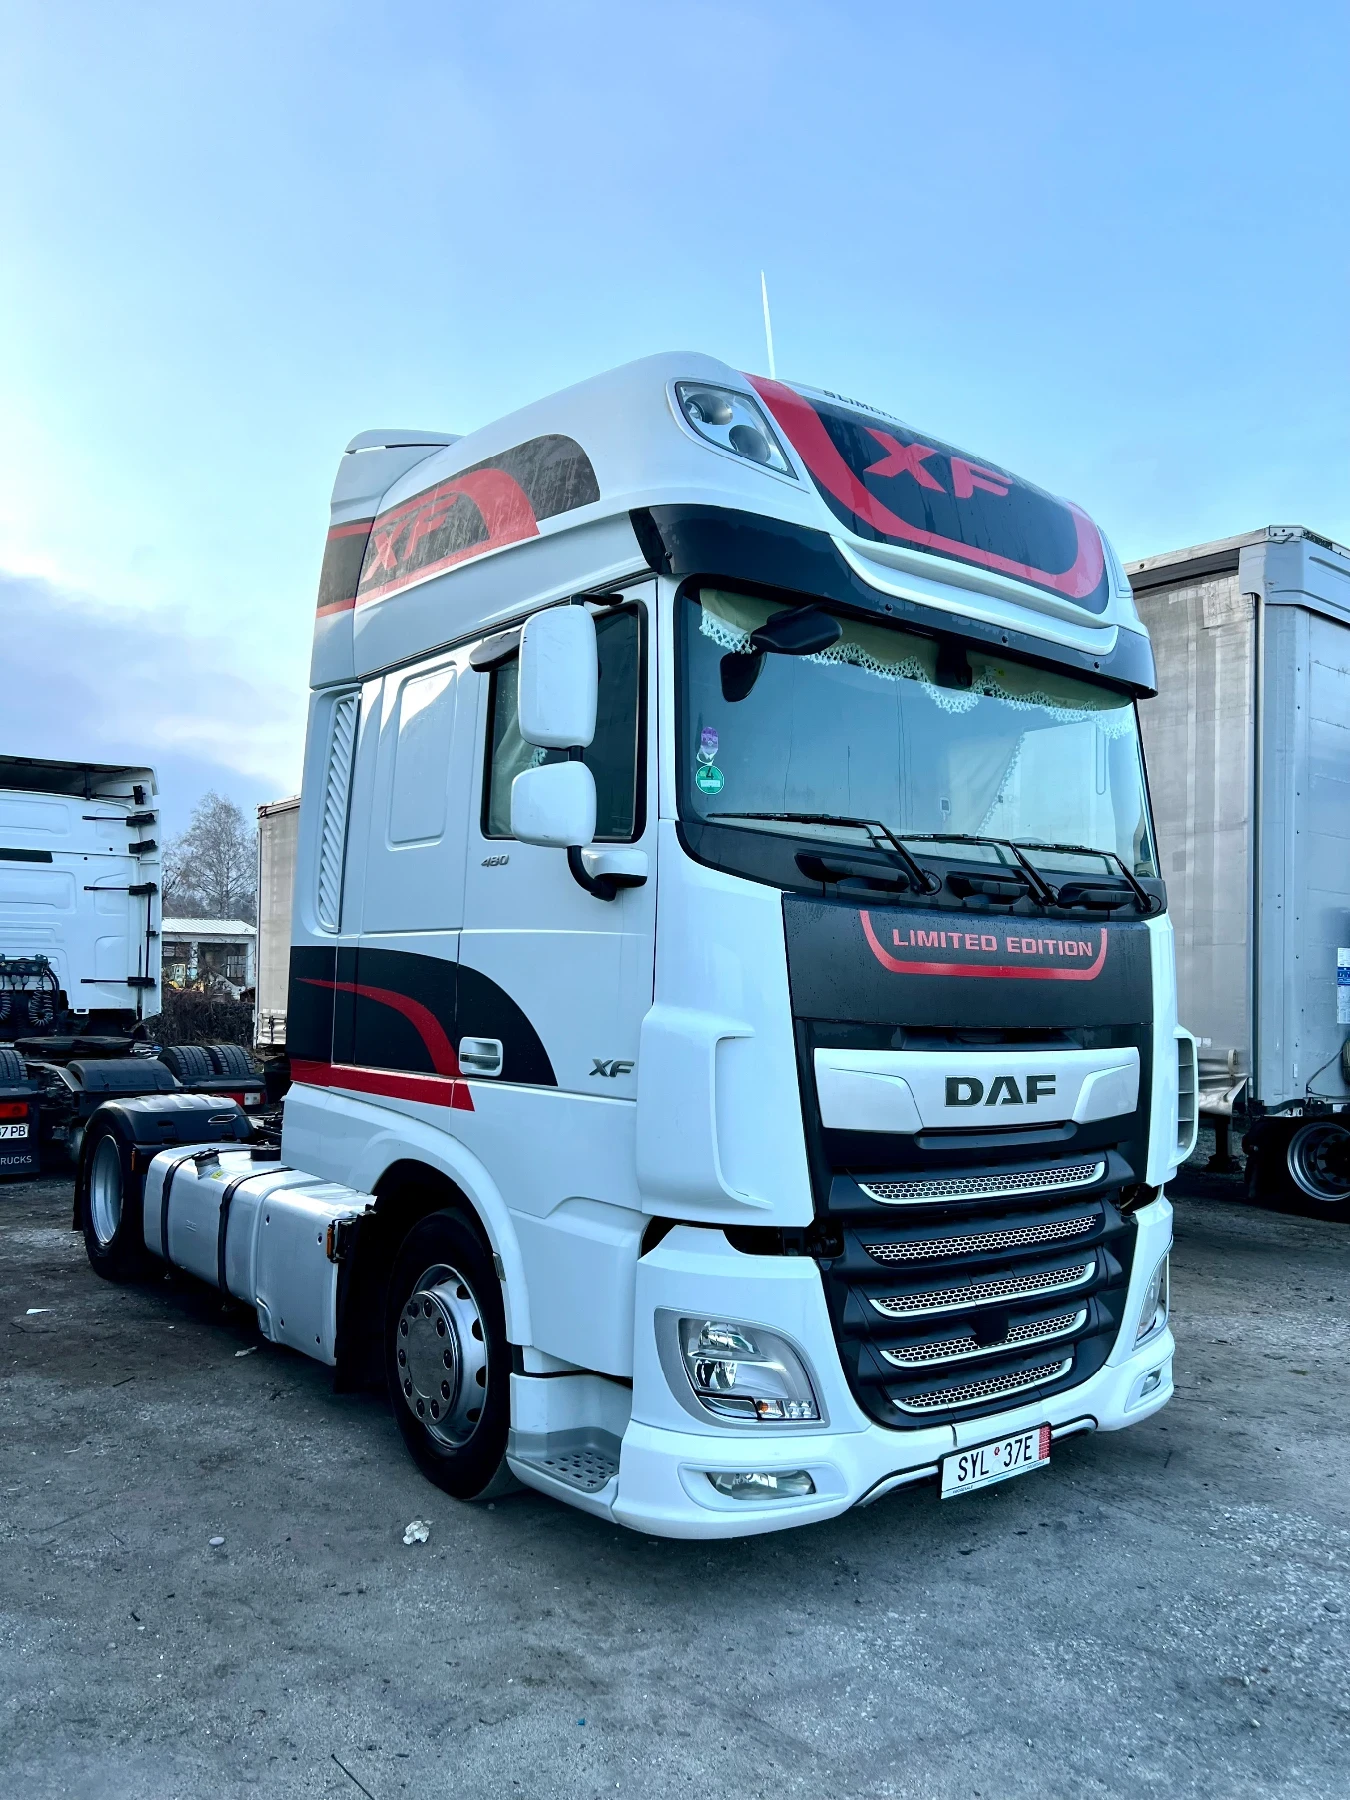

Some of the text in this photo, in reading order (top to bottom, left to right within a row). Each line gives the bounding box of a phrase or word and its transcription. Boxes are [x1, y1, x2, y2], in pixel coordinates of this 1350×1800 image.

[863, 426, 1013, 499] XF
[361, 492, 458, 583] XF
[481, 854, 509, 867] 480
[892, 929, 1093, 957] LIMITED EDITION
[588, 1058, 635, 1078] XF
[944, 1074, 1057, 1107] DAF
[958, 1451, 990, 1482] SYL
[1003, 1435, 1033, 1467] 37E
